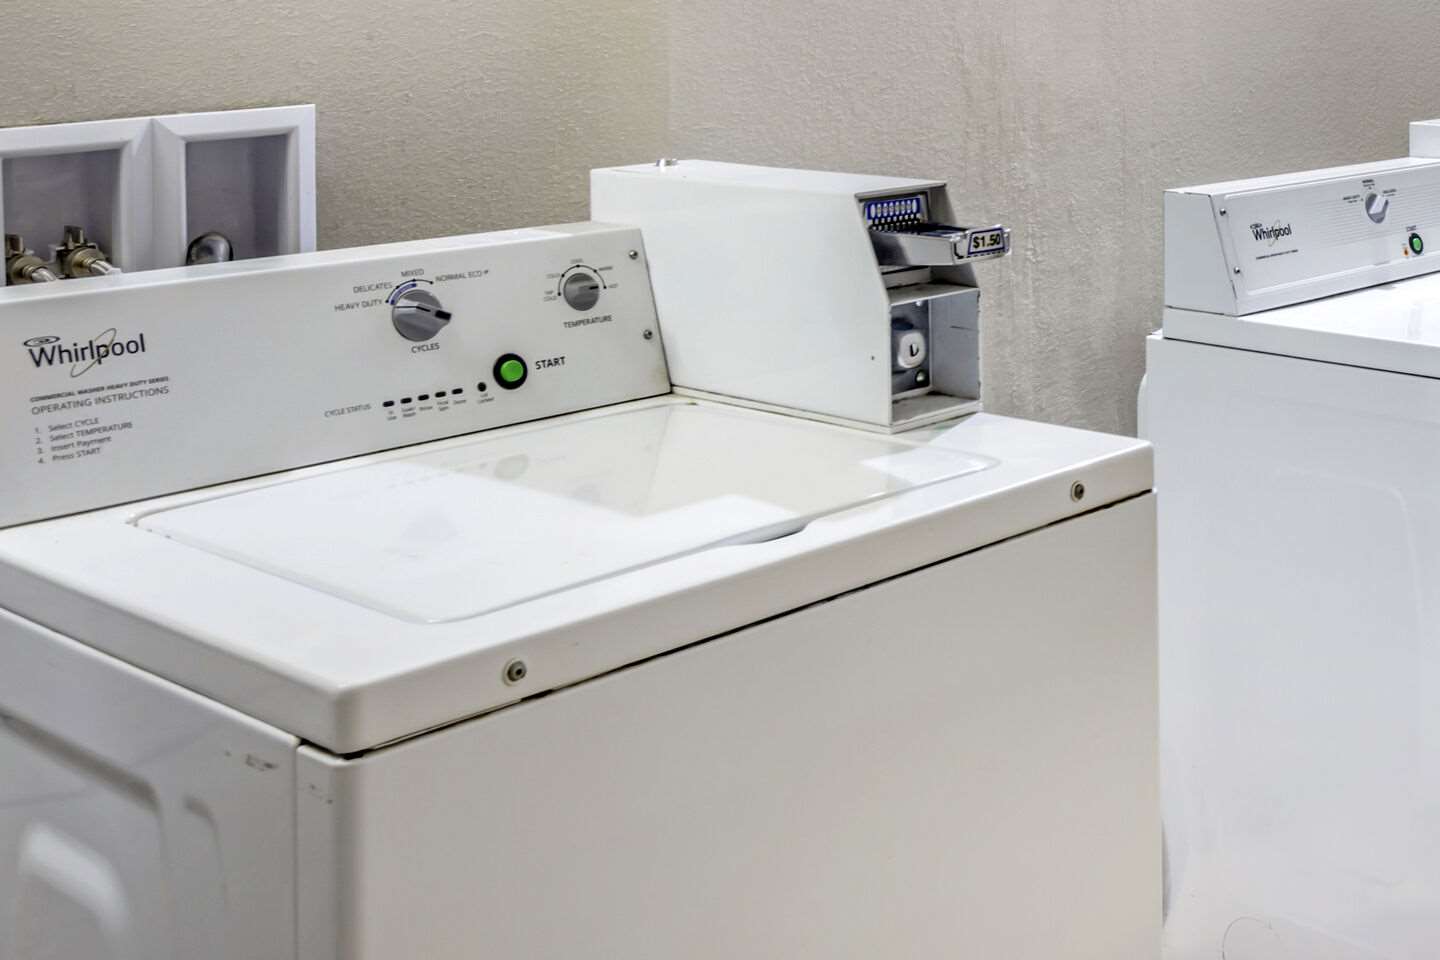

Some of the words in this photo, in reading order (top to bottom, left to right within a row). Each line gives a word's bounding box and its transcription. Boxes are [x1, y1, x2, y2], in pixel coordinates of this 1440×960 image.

[1252, 223, 1293, 241] Whirlpool
[972, 233, 1001, 249] $1.50
[353, 282, 393, 294] DELICATES
[334, 302, 360, 312] HEAVY
[362, 299, 382, 309] DUTY
[28, 333, 146, 368] Whirlpool
[411, 342, 440, 354] CYCLES
[535, 356, 566, 370] START
[31, 398, 92, 416] OPERATING
[94, 385, 170, 407] INSTRUCTIONS
[48, 422, 73, 432] Select
[74, 417, 99, 427] CYCLE
